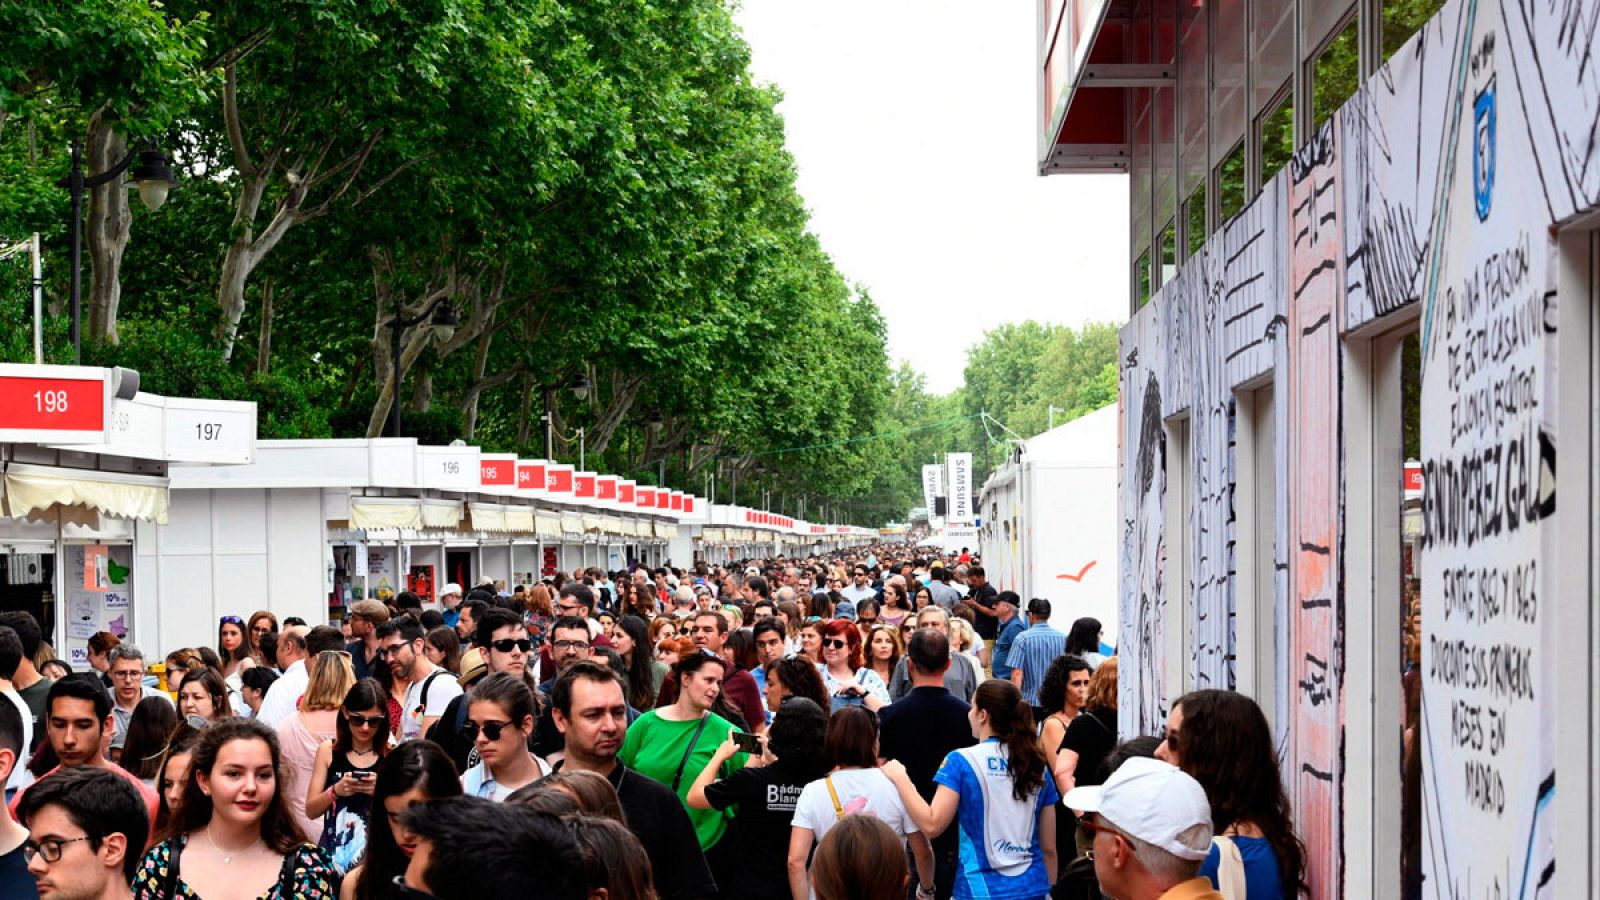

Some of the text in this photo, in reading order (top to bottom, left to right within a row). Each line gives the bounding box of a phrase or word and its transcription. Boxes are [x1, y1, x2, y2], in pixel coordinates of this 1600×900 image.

[1462, 265, 1480, 323] UNA
[1448, 344, 1460, 392] DE
[1491, 303, 1518, 362] CASA
[34, 390, 68, 412] 198
[1451, 364, 1538, 448] EL JOVEN ESCRITOR
[196, 423, 222, 441] 197
[443, 461, 459, 474] 196
[481, 467, 497, 479] 195
[956, 459, 965, 517] SAMSUNG
[1443, 563, 1475, 624] ENTRE
[1502, 567, 1509, 620] Y
[1451, 699, 1506, 756] MESES EN
[1465, 760, 1505, 819] MADRID
